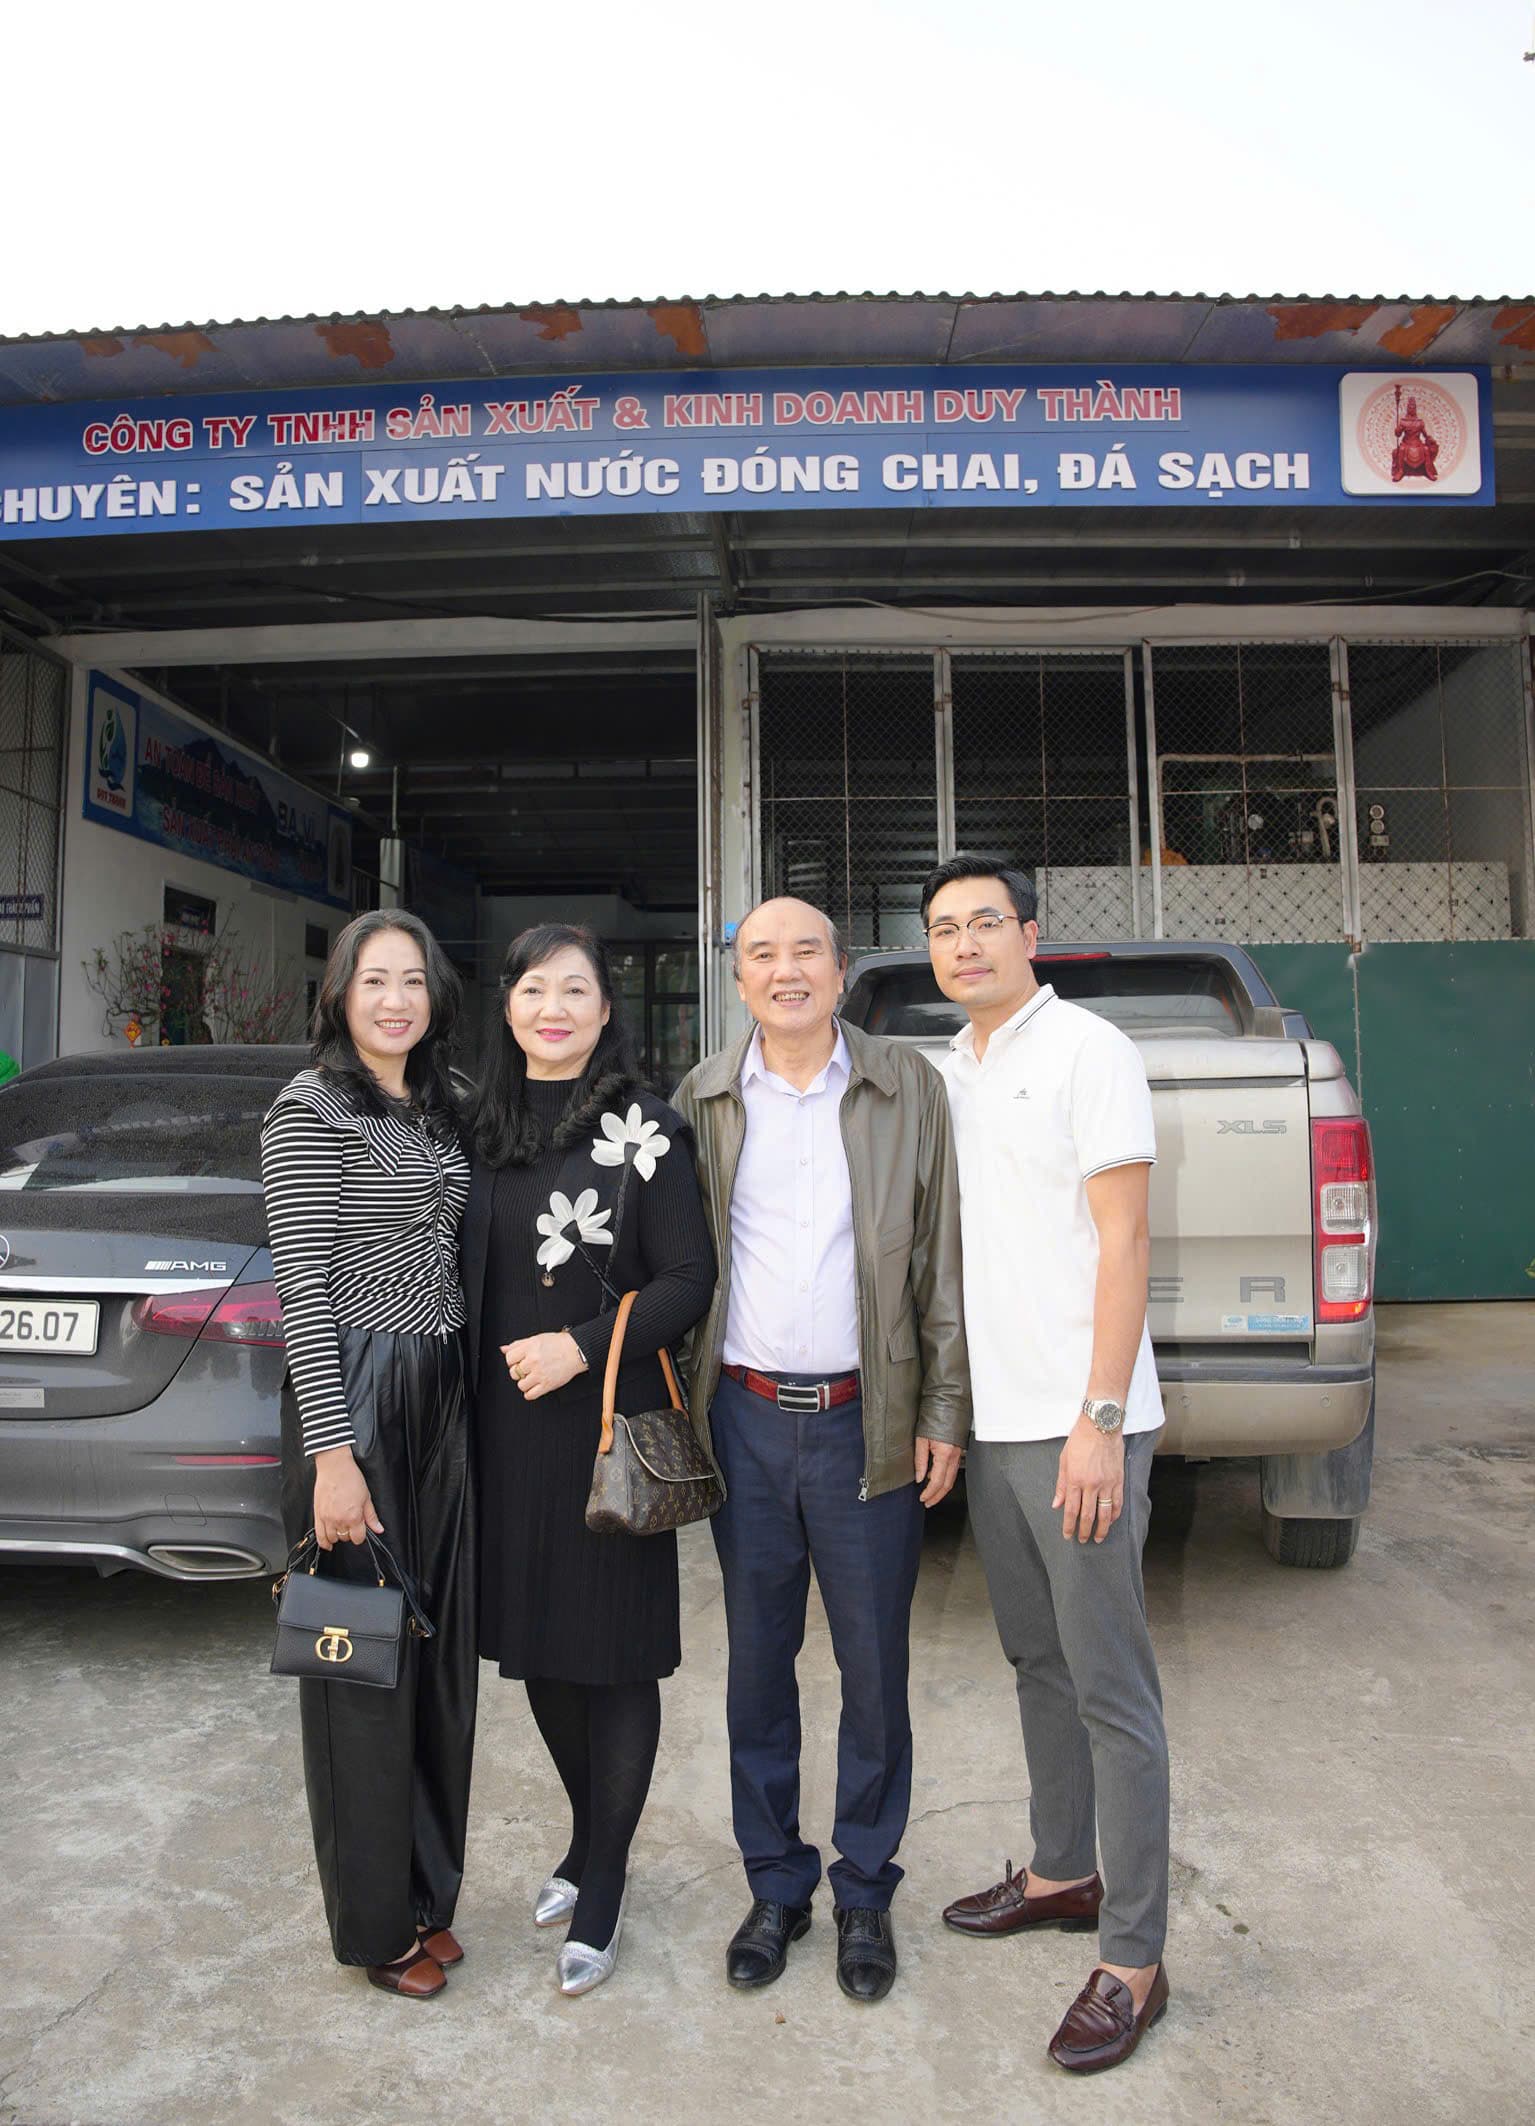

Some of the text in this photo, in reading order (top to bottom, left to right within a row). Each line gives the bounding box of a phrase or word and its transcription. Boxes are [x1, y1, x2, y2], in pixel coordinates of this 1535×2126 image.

[82, 379, 1182, 455] CÔNG TY TNHH SẢN XUẤT & KINH DOANH DUY THÀNH
[0, 443, 1311, 524] HUYÊN: SẢN XUẤT NƯỚC ĐÓNG CHAI, ĐÁ SẠCH
[1216, 1119, 1288, 1135] XLS
[169, 1260, 228, 1271] AMG
[0, 1310, 79, 1342] 26.07
